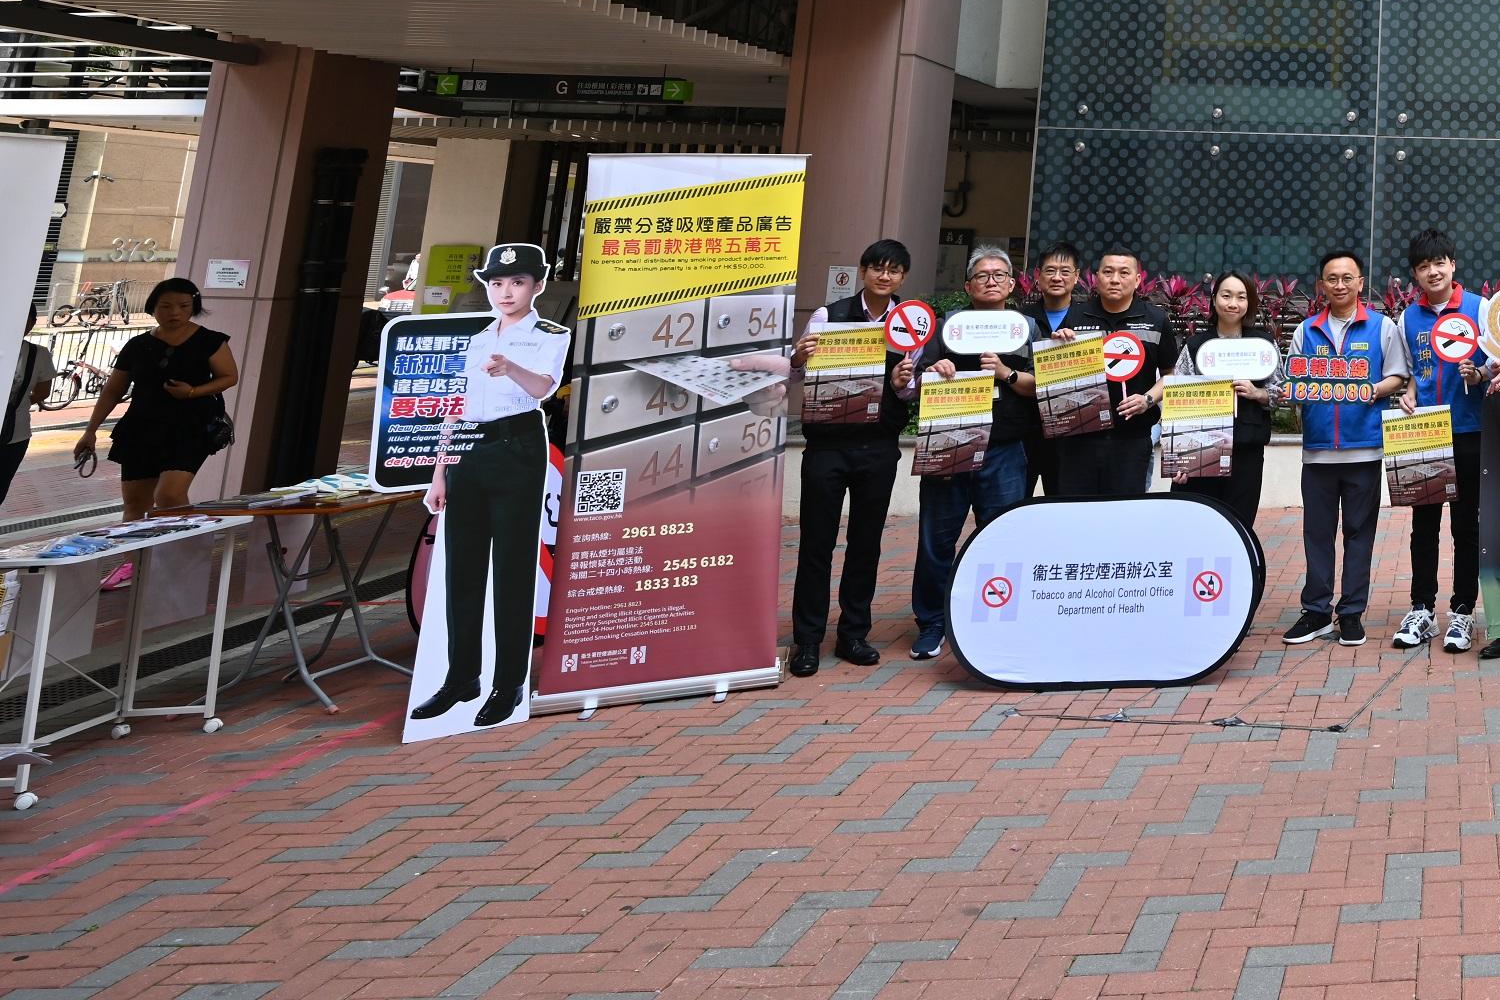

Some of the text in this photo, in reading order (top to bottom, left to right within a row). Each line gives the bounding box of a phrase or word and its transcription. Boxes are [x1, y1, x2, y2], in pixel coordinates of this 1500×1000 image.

[555, 80, 568, 95] G
[593, 215, 793, 234] 嚴禁分發吸煙產品廣告
[110, 237, 157, 262] 373
[600, 236, 782, 256] 最高罰款港幣五萬元
[652, 312, 695, 348] 42
[747, 308, 777, 337] 54
[396, 336, 470, 352] 私煙罪行
[393, 354, 468, 376] 新刑責
[1288, 356, 1369, 380] 舉報熱線
[392, 378, 467, 394] 違者必究
[1283, 383, 1372, 402] 1828080
[389, 396, 465, 418] 要守法
[388, 422, 479, 434] New penalties for
[740, 418, 772, 453] 56
[411, 434, 448, 443] cigarette
[449, 432, 484, 440] offences
[386, 442, 474, 454] No one should
[384, 456, 461, 468] defy the law
[640, 444, 684, 486] 44
[574, 513, 622, 522] www.taco.gov.hk
[622, 526, 656, 539] 2961
[660, 522, 694, 536] 8823
[663, 558, 697, 572] 2545
[700, 554, 734, 568] 6182
[635, 578, 670, 591] 1833
[673, 575, 698, 588] 183
[1032, 587, 1174, 600] Tobacco and Alcohol Control Office
[566, 606, 588, 614] Enquiry
[1058, 603, 1144, 616] Department of Health
